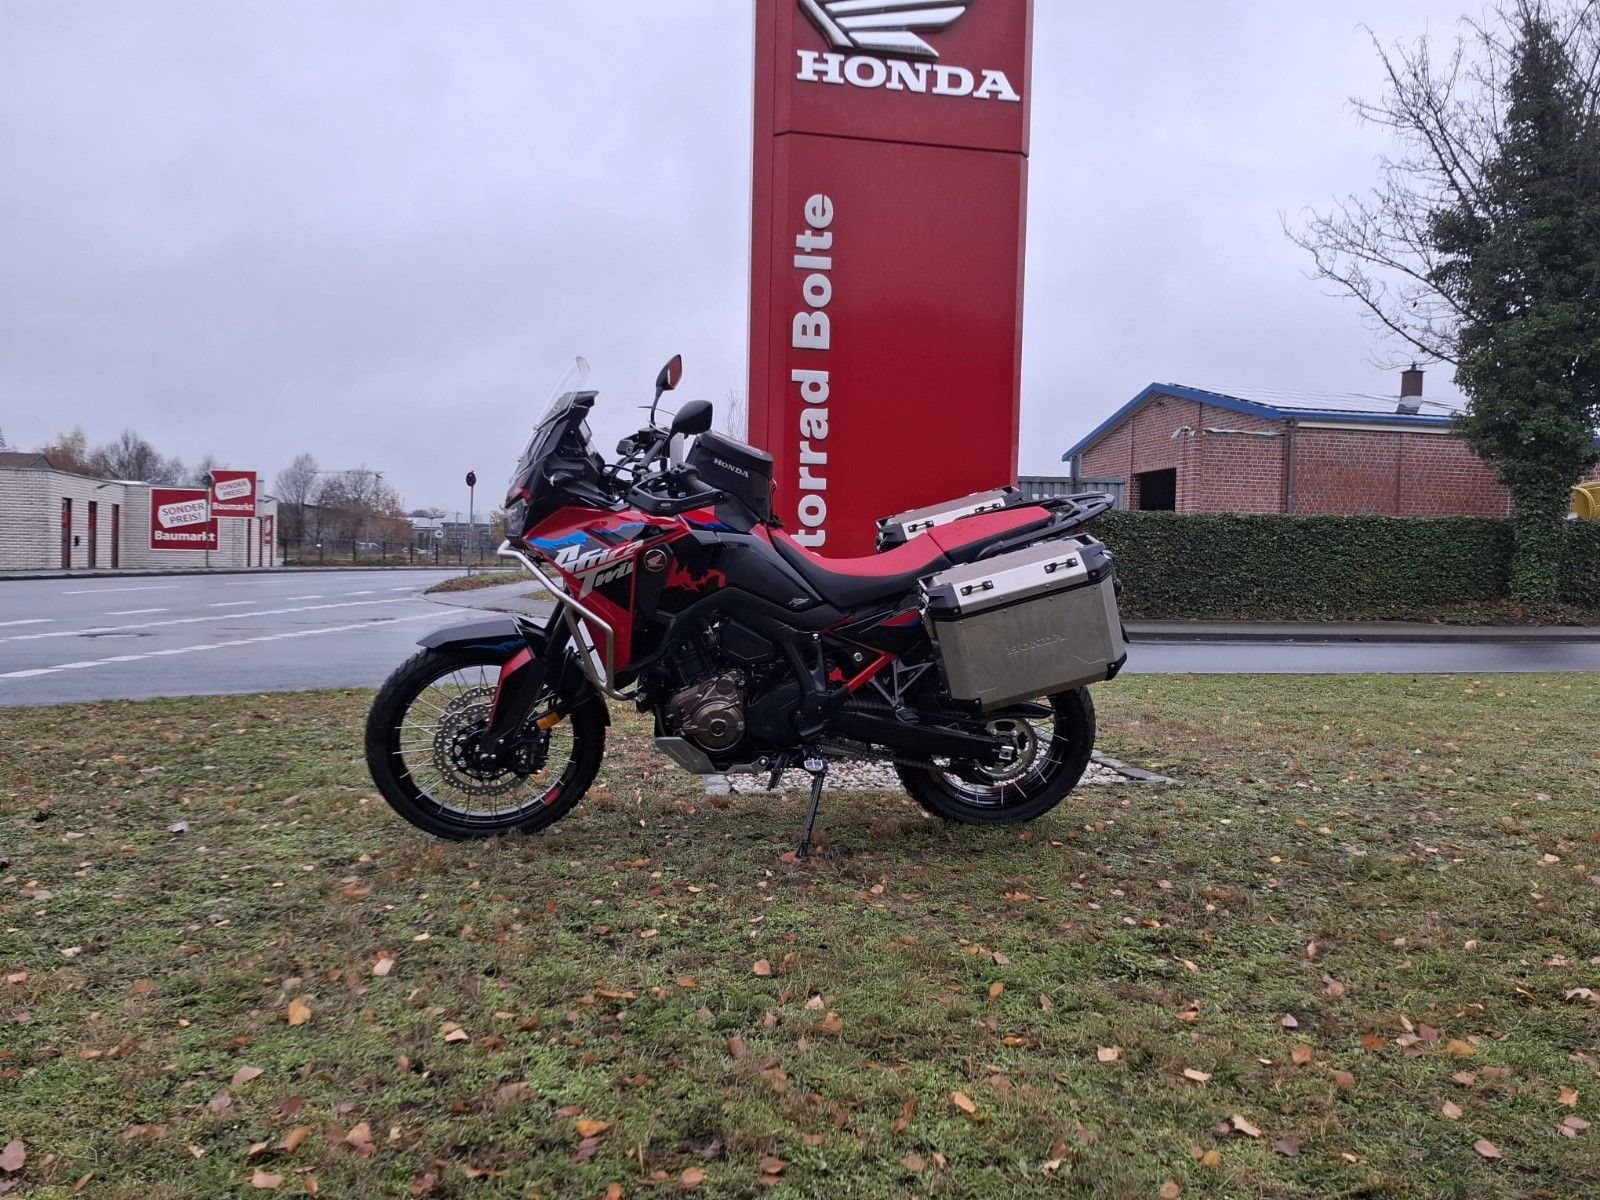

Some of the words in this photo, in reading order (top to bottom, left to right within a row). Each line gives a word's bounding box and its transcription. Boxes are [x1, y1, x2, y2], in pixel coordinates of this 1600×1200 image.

[796, 50, 1021, 102] HONDA
[792, 194, 834, 350] Bolte
[713, 457, 750, 479] HONDA
[161, 502, 205, 516] SONDER
[212, 502, 254, 511] Baumarkt
[169, 512, 202, 525] PREIS!
[154, 530, 215, 542] Baumarkt
